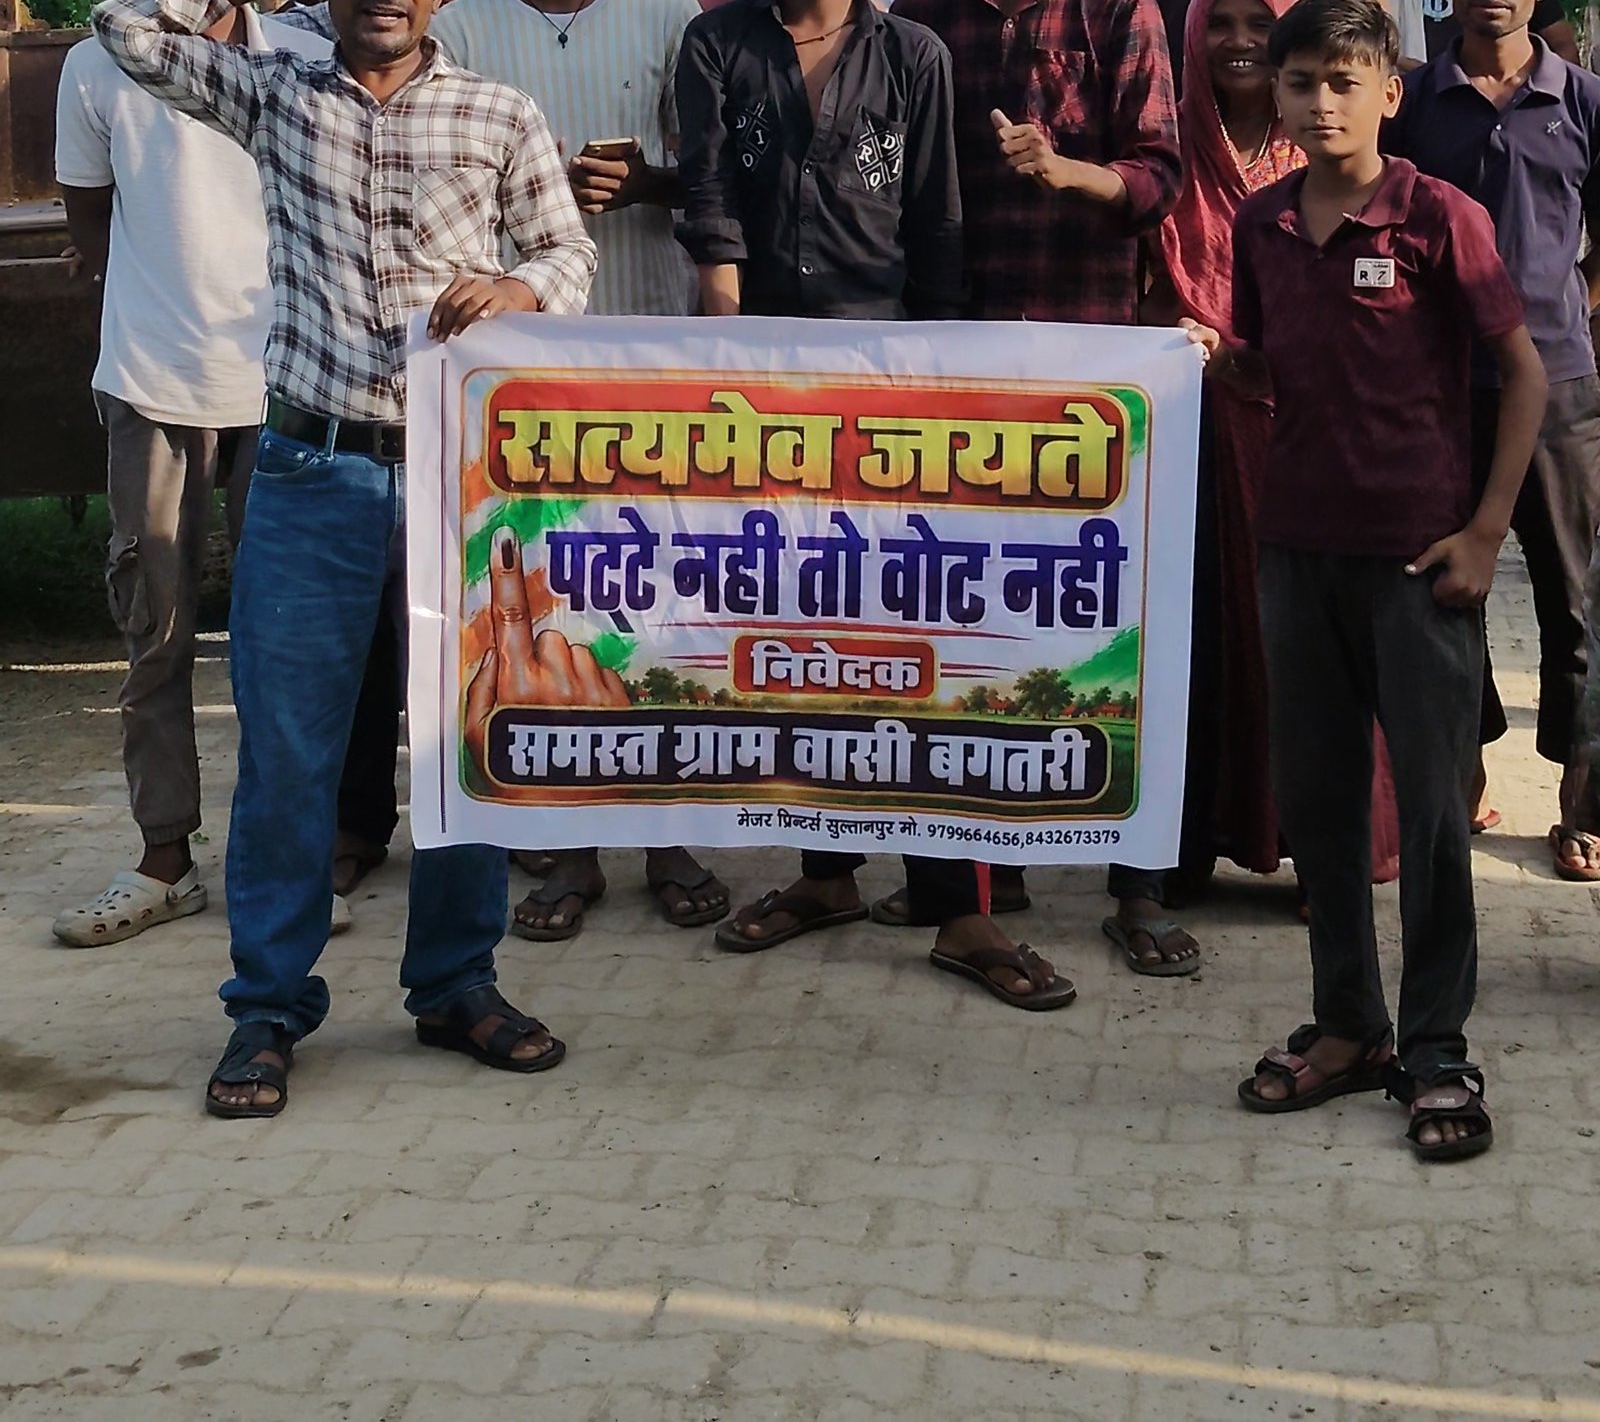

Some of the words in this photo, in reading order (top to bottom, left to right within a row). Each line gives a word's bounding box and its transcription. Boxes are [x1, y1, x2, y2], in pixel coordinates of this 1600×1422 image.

[1359, 270, 1369, 281] R
[498, 391, 842, 489] सत्यमेव
[857, 403, 1117, 499] जयते
[671, 510, 786, 616] नही
[797, 511, 870, 618] तो
[879, 514, 991, 624] वोट
[1001, 518, 1129, 628] नही
[750, 640, 921, 690] निवेदक
[508, 724, 664, 777] समस्त
[673, 725, 781, 779] ग्राम
[792, 719, 916, 784] वासी
[927, 727, 1091, 793] बगतरी
[737, 807, 773, 828] मेजर
[776, 807, 823, 832] प्रिन्टर्स
[824, 817, 896, 841] सुल्तानपुर
[898, 815, 922, 838] मो.
[927, 823, 1121, 849] 9799664656,8432673379
